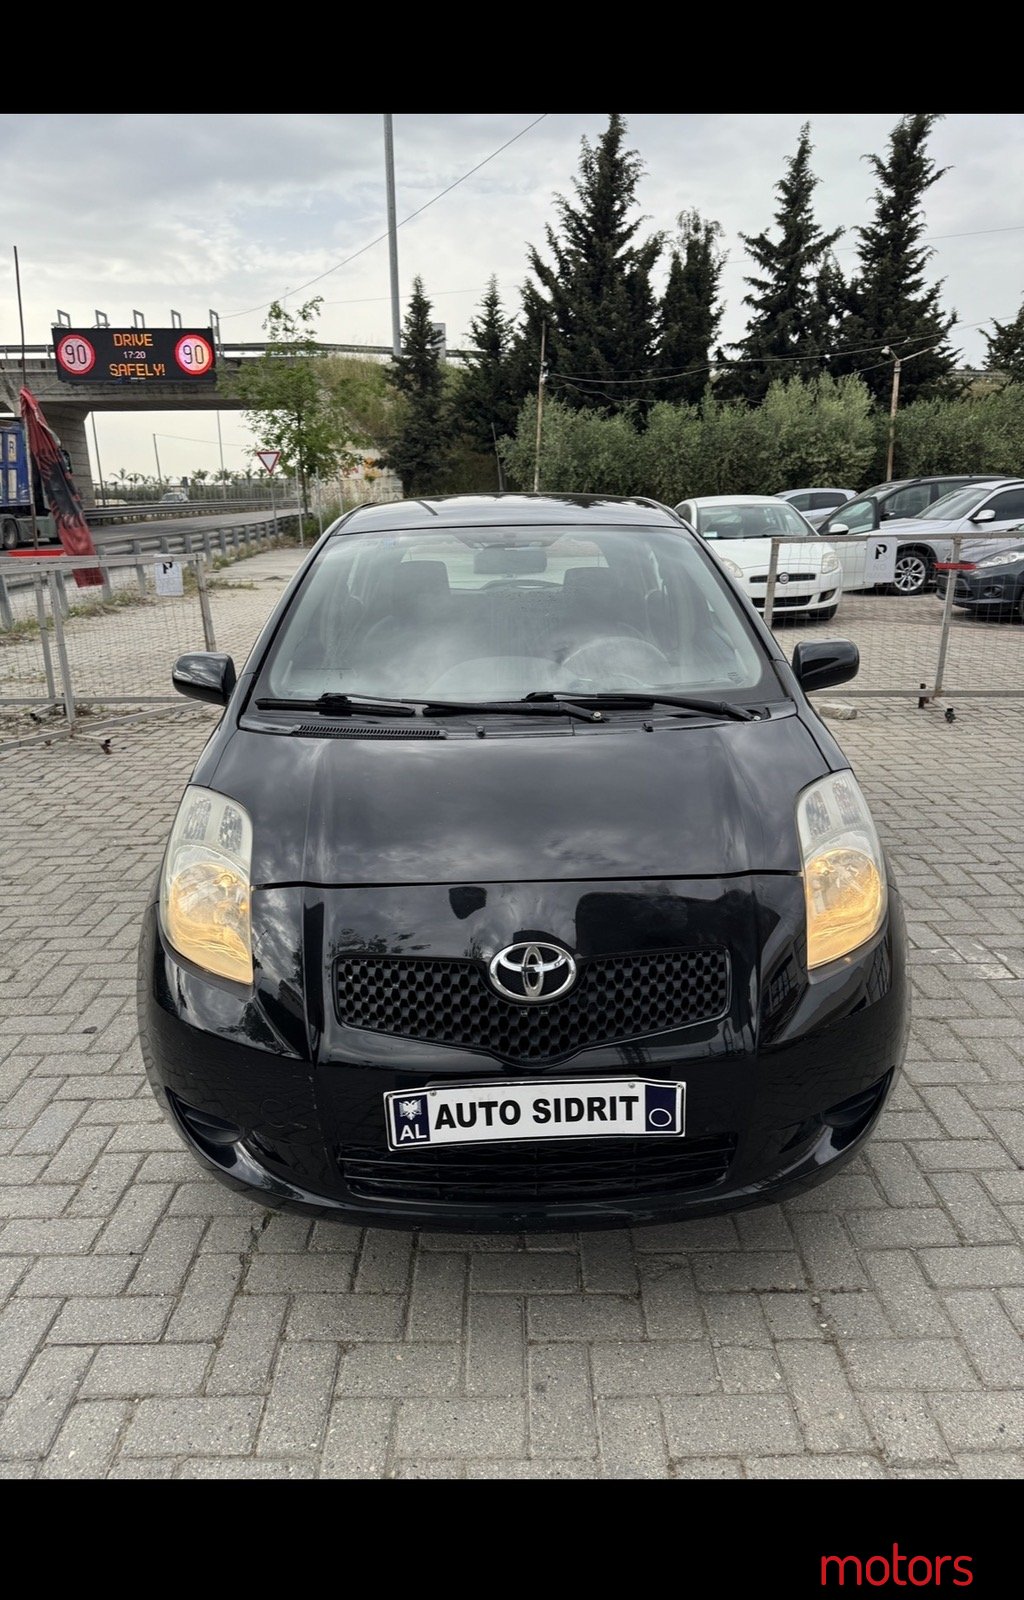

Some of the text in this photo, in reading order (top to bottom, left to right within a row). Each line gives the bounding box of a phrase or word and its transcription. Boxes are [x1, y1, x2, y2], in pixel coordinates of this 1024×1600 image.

[113, 334, 154, 346] DRIVE
[65, 344, 87, 365] 90
[123, 351, 146, 359] 17:20
[183, 344, 205, 365] 90
[109, 363, 166, 377] SAFELY!
[434, 1096, 639, 1130] AUTO SIDRIT
[400, 1124, 427, 1140] AL
